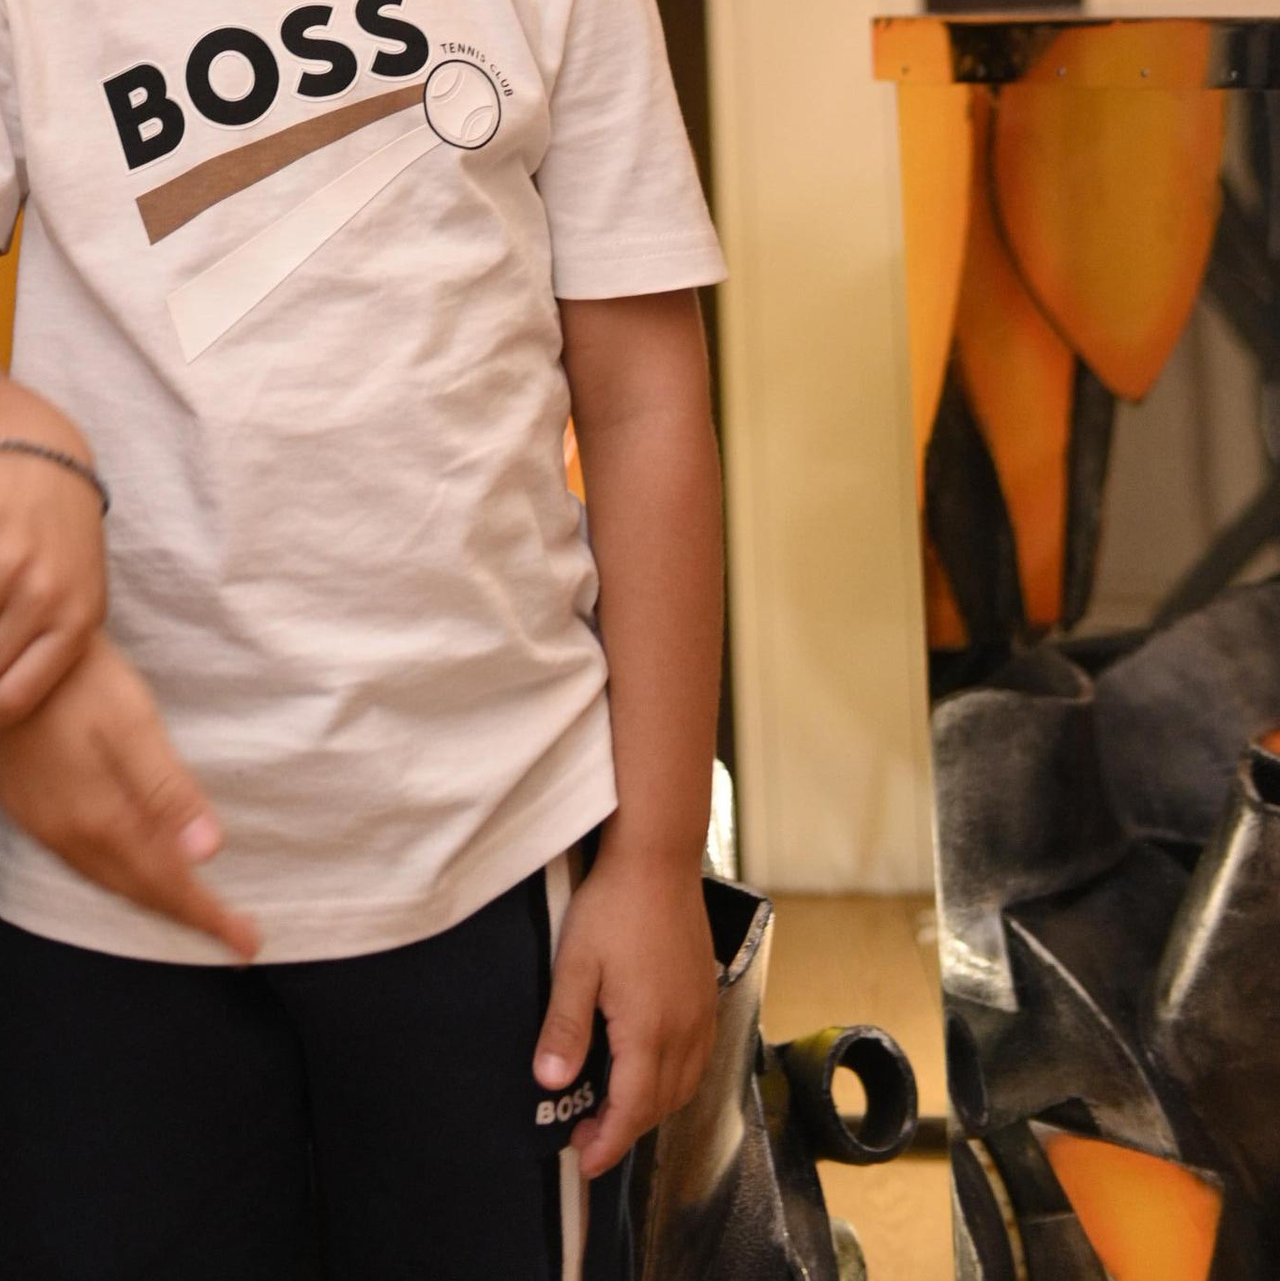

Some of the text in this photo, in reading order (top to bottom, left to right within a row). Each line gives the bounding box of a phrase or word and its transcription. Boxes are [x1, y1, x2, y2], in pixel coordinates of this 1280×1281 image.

[439, 42, 515, 97] TENNIS CLUB
[535, 1081, 595, 1126] BOSS
